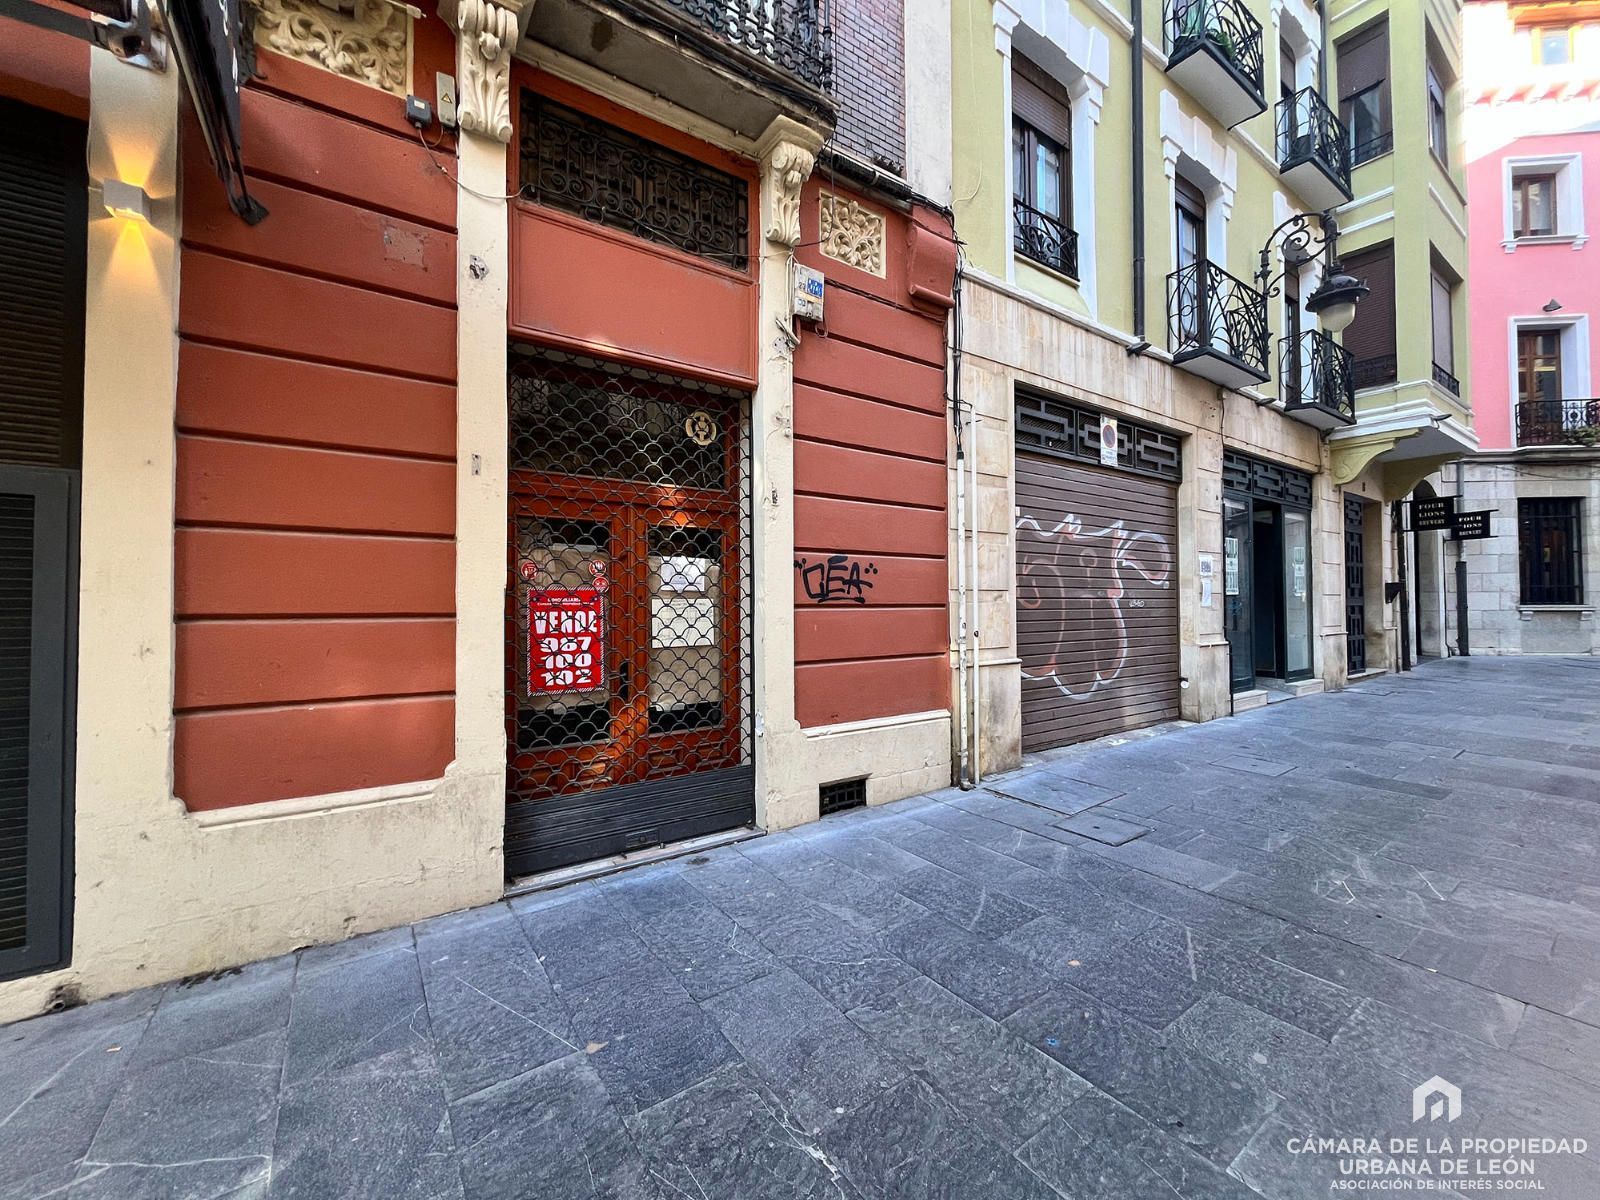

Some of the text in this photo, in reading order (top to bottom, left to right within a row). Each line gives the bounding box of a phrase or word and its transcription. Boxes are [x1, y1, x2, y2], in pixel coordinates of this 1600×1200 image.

[534, 610, 598, 634] VENDE
[540, 636, 592, 653] 987
[540, 653, 592, 669] 100
[540, 668, 592, 687] 102
